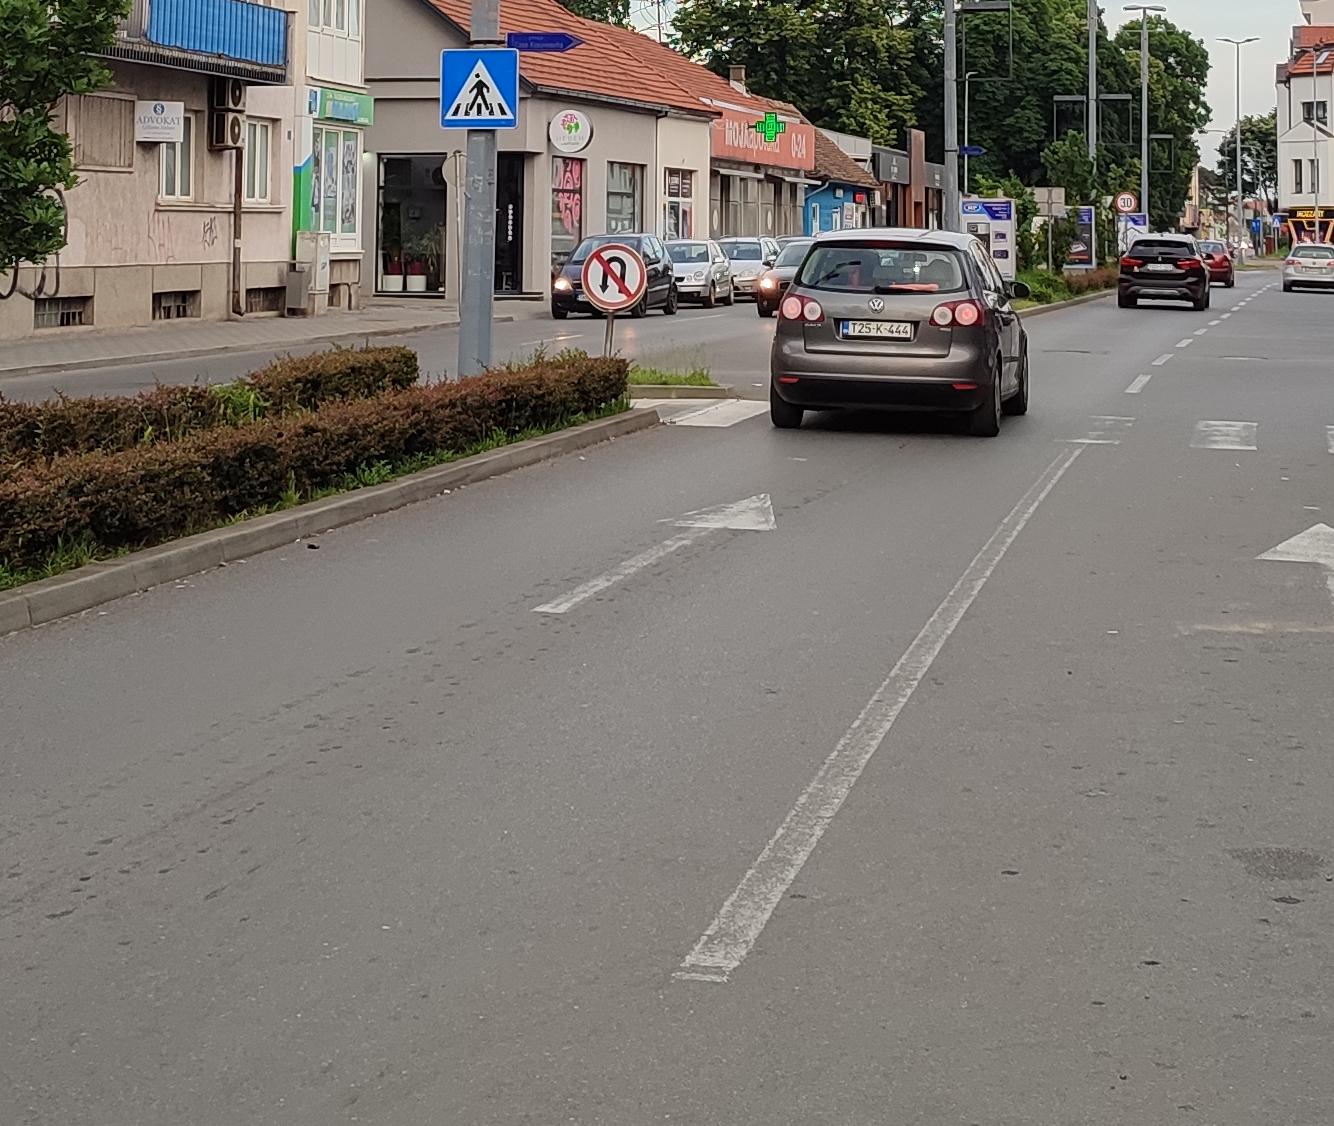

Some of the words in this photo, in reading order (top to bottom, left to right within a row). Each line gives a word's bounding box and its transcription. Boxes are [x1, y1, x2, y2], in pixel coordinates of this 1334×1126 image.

[137, 116, 181, 125] ADVOKAT
[791, 133, 806, 159] 0-24
[1120, 197, 1132, 208] 30
[851, 322, 909, 336] T25-K-444
